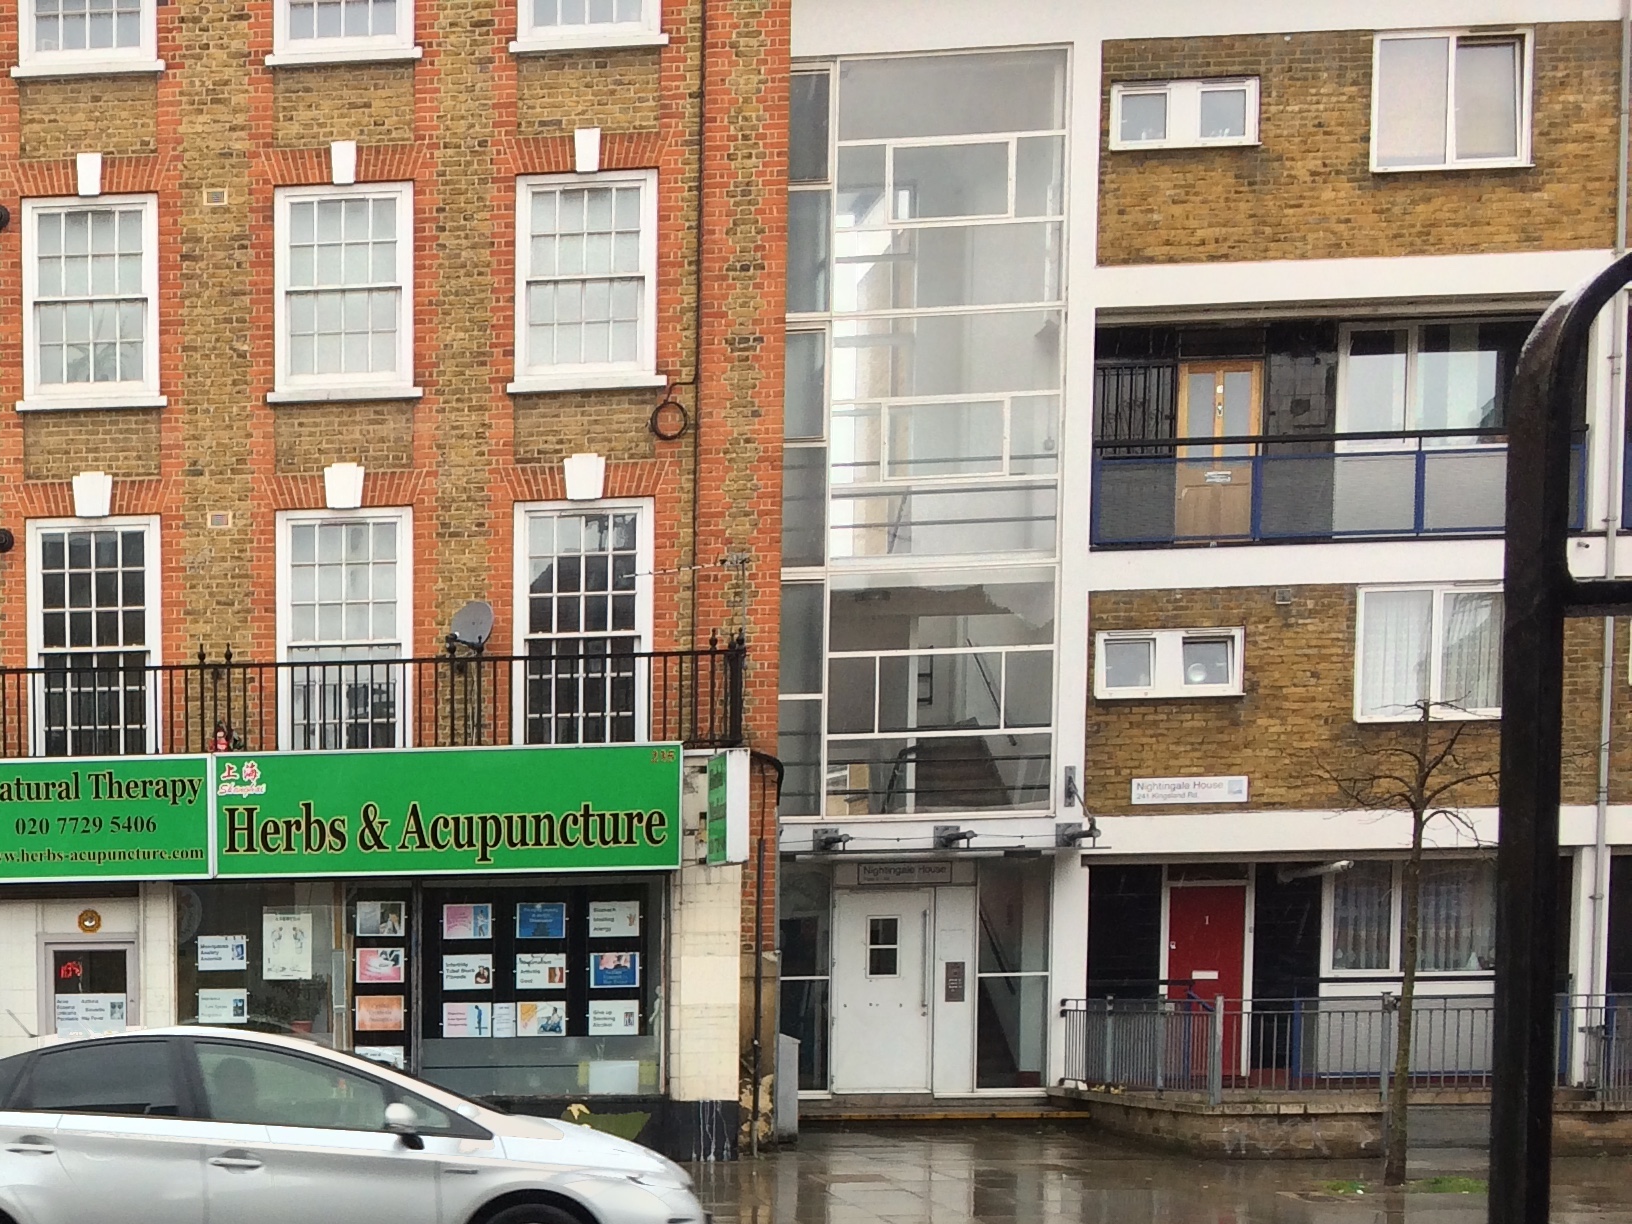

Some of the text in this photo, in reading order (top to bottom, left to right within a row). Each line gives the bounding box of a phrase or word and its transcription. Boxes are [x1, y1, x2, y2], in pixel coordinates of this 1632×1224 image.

[87, 769, 203, 806] Therapy
[217, 782, 266, 798] Shanghai
[1136, 780, 1224, 792] Nightingale House
[15, 815, 157, 835] 020 7729 5406
[223, 800, 348, 855] Herbs
[358, 801, 391, 852] &
[397, 801, 667, 864] Acupuncture
[863, 865, 947, 877] Nightingale House
